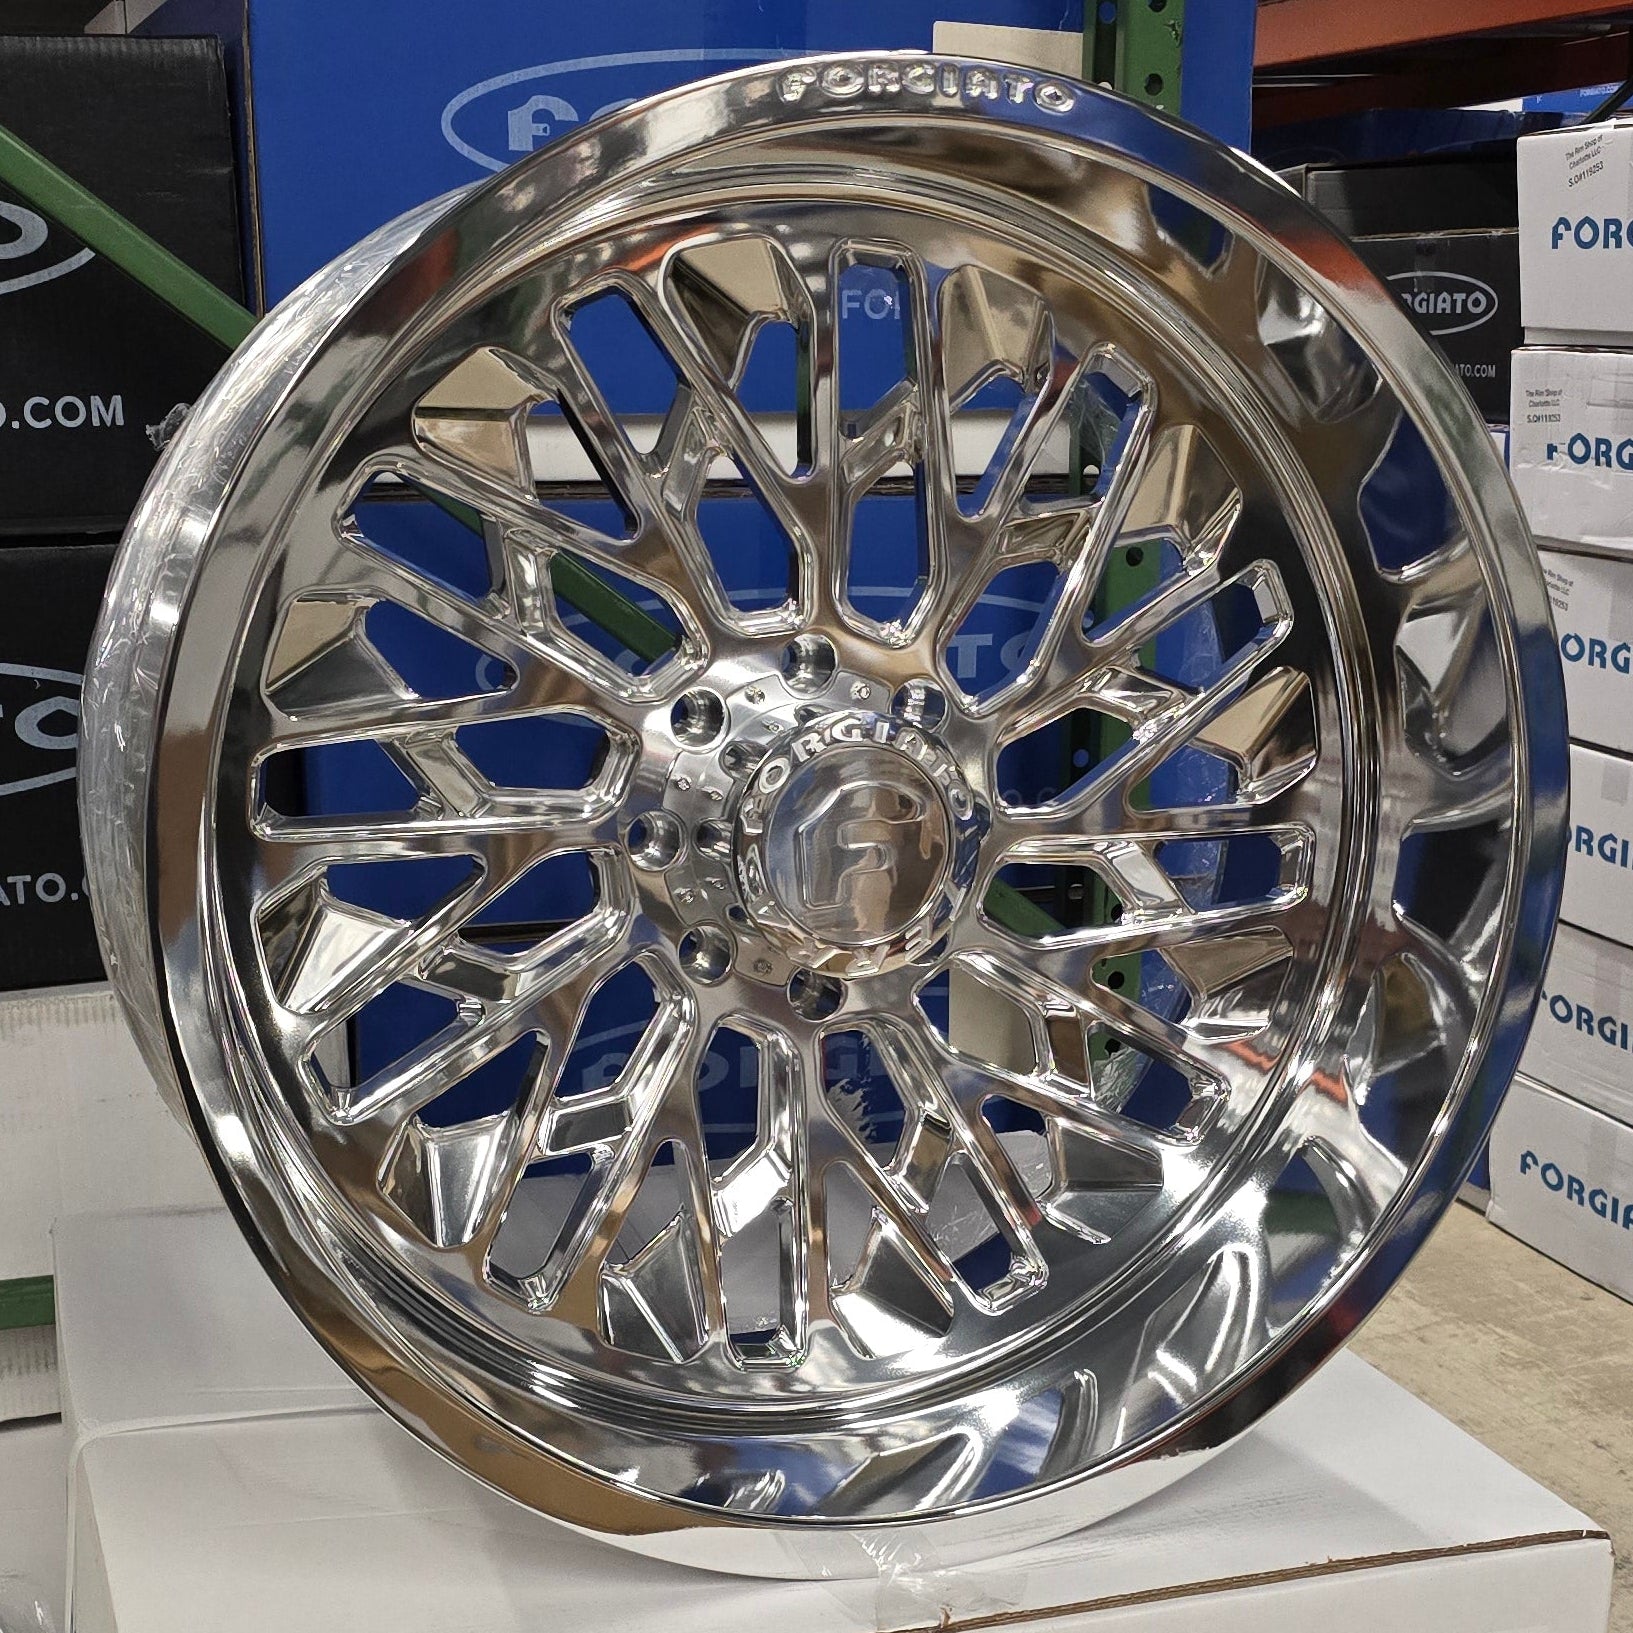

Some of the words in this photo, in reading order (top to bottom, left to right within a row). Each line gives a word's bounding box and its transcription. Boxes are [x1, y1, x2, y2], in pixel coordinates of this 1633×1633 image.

[776, 61, 1077, 114] FORGIATO
[1551, 215, 1633, 250] FOR
[0, 394, 125, 430] .COM
[1566, 825, 1633, 871] RGI
[0, 871, 91, 906] TO.
[1541, 988, 1633, 1053] ORGI
